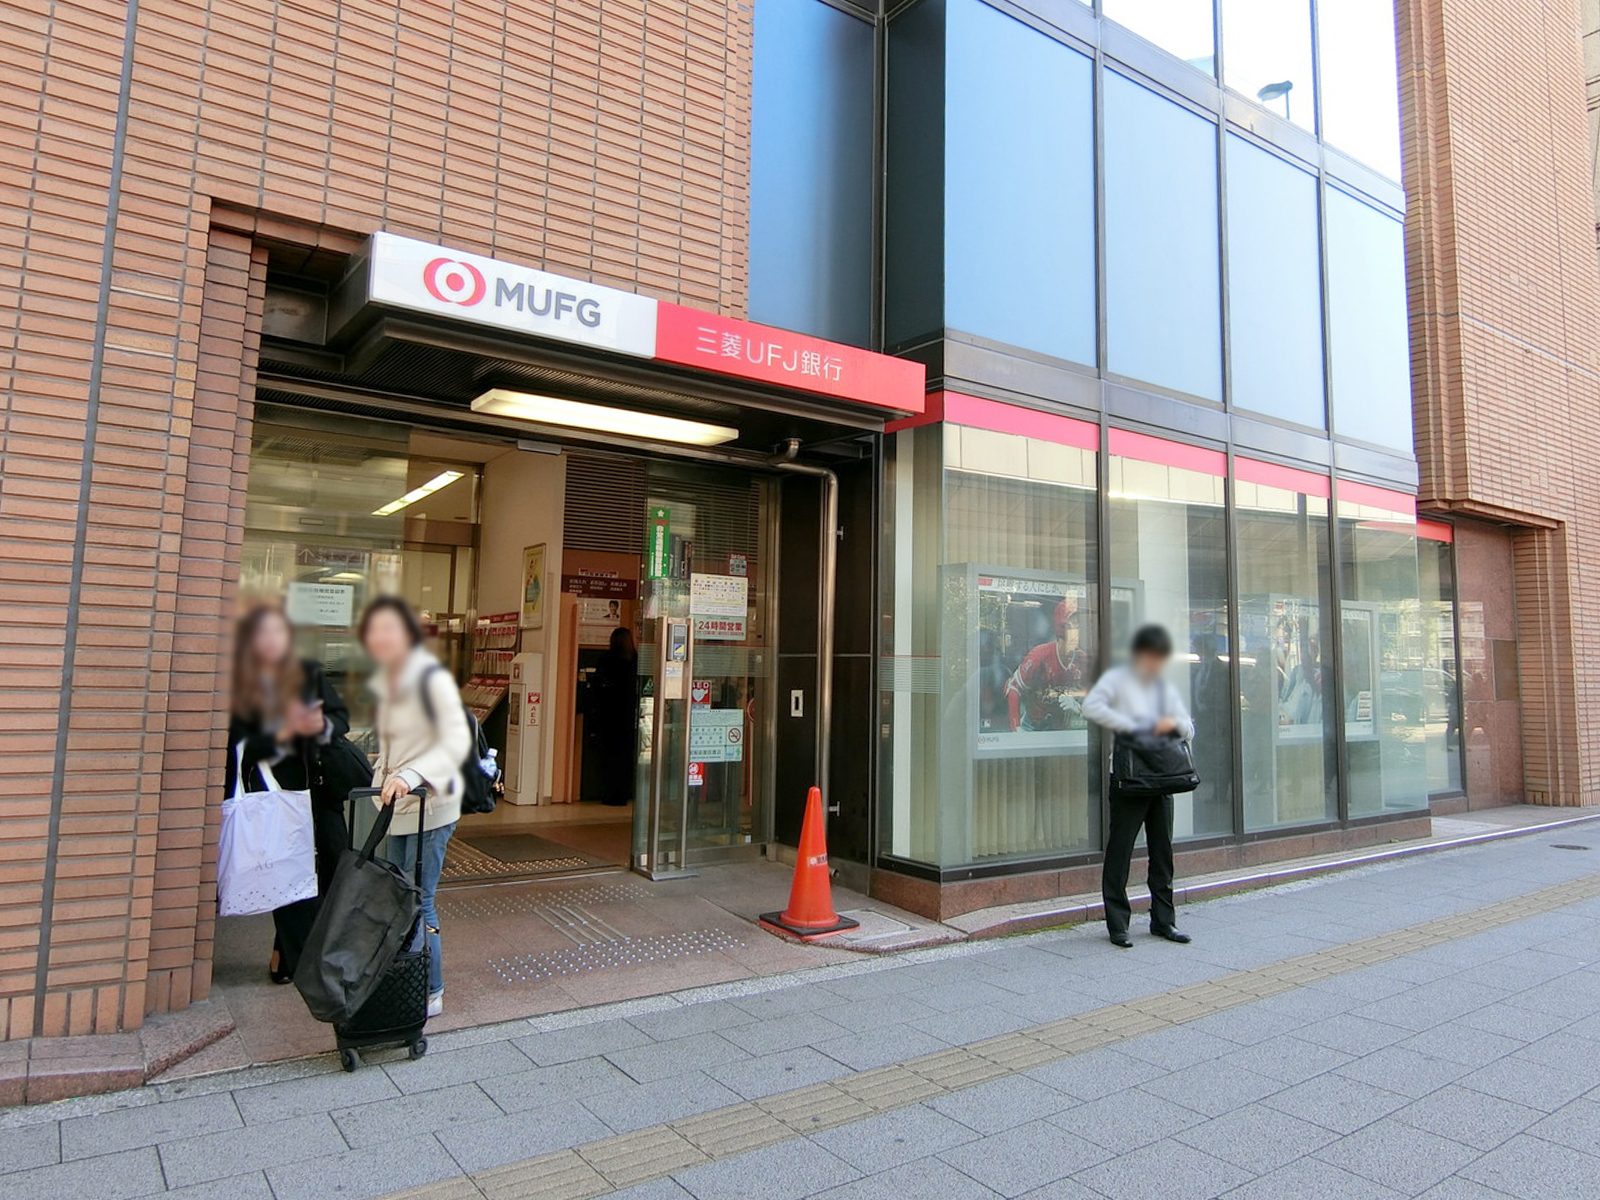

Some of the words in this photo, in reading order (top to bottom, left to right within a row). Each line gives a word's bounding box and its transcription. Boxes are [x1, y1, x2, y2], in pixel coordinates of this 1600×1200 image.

[495, 277, 601, 328] MUFG
[696, 326, 842, 382] 三菱UFJ銀行
[698, 620, 743, 631] 24時間営業
